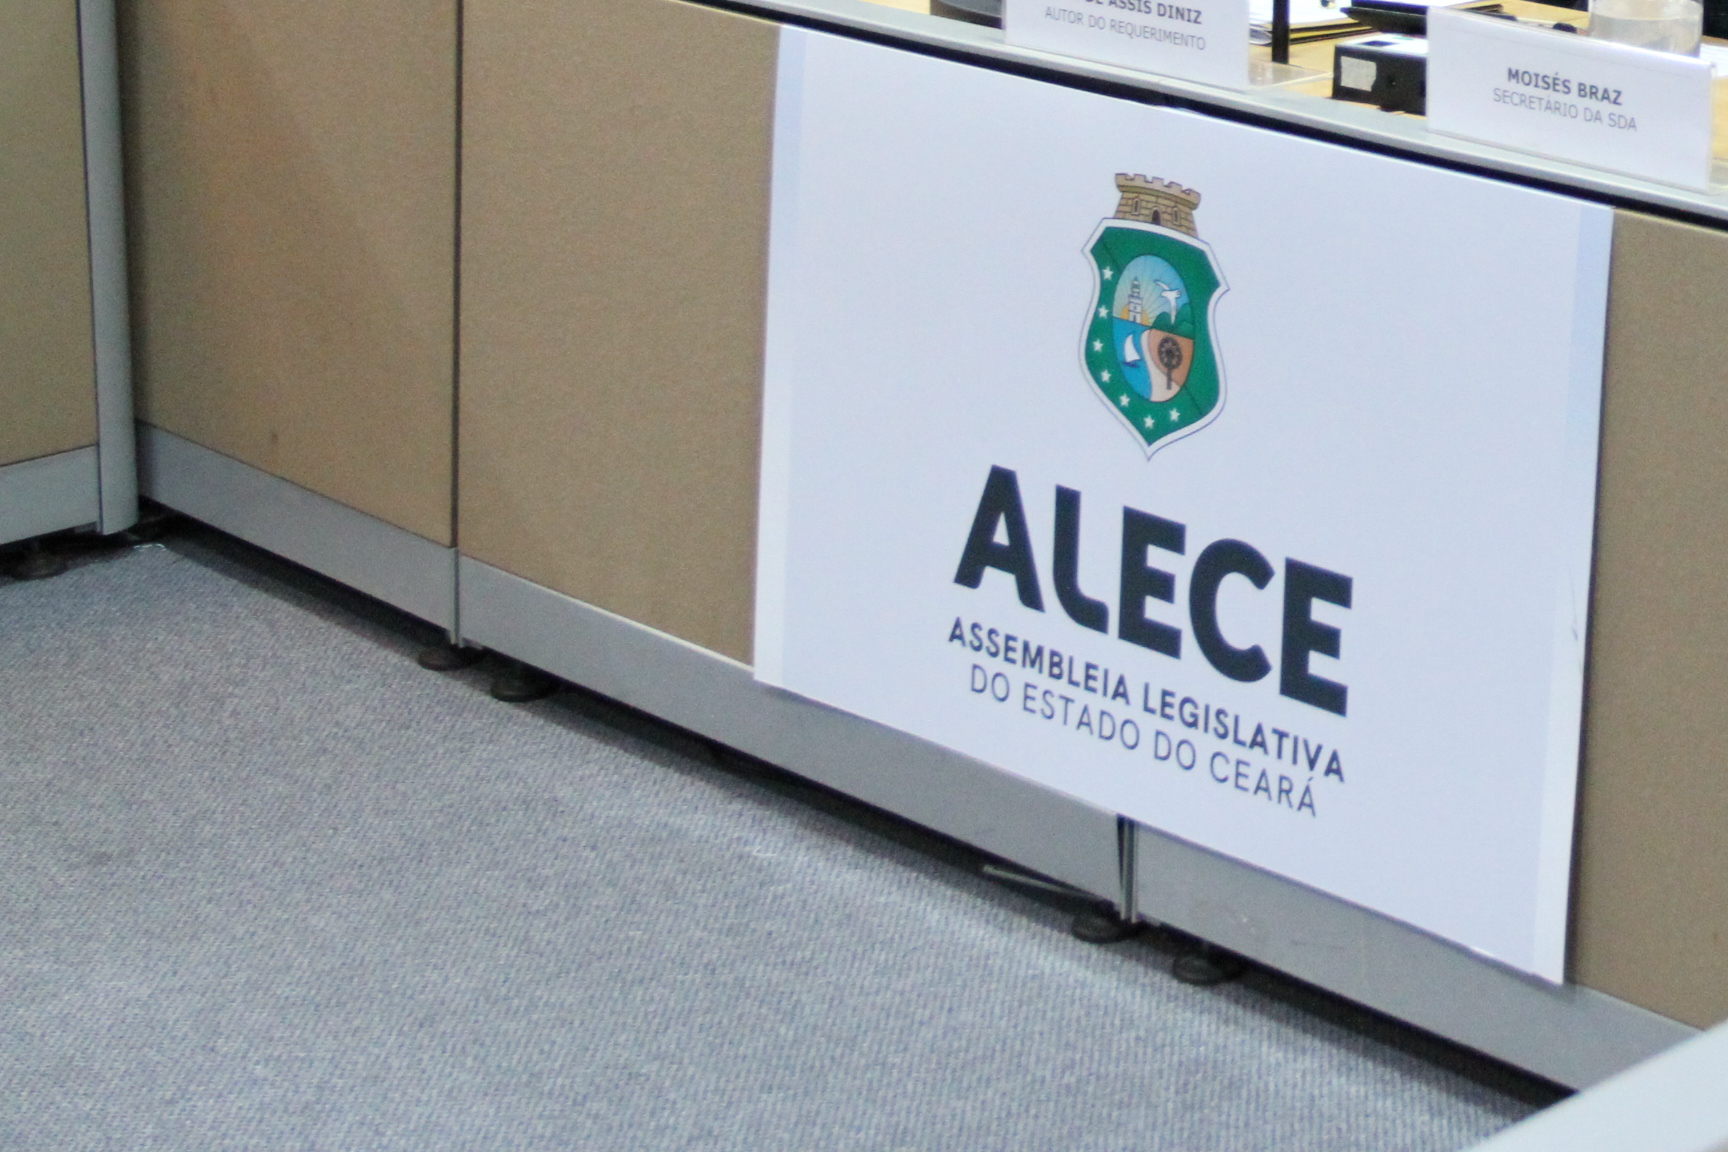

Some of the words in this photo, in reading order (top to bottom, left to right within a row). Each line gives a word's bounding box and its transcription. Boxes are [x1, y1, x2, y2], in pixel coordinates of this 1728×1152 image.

[1045, 6, 1084, 27] AUTOR
[1088, 16, 1105, 30] DO
[1110, 19, 1206, 51] REQUERIMENTO
[1157, 2, 1202, 25] DINIZ
[1507, 67, 1571, 95] MOISÉS
[1577, 81, 1623, 106] BRAZ
[1493, 87, 1578, 119] SECRETÁRIO
[1583, 107, 1603, 124] DA
[1607, 113, 1637, 132] SDA
[953, 464, 1353, 717] ALECE
[949, 616, 1129, 706] ASSEMBLEIA
[1143, 681, 1345, 783] LEGISLATIVA
[971, 663, 1010, 703] DO
[1023, 683, 1141, 751] ESTADO
[1155, 730, 1197, 771] DO
[1210, 749, 1317, 817] CEARÁ
